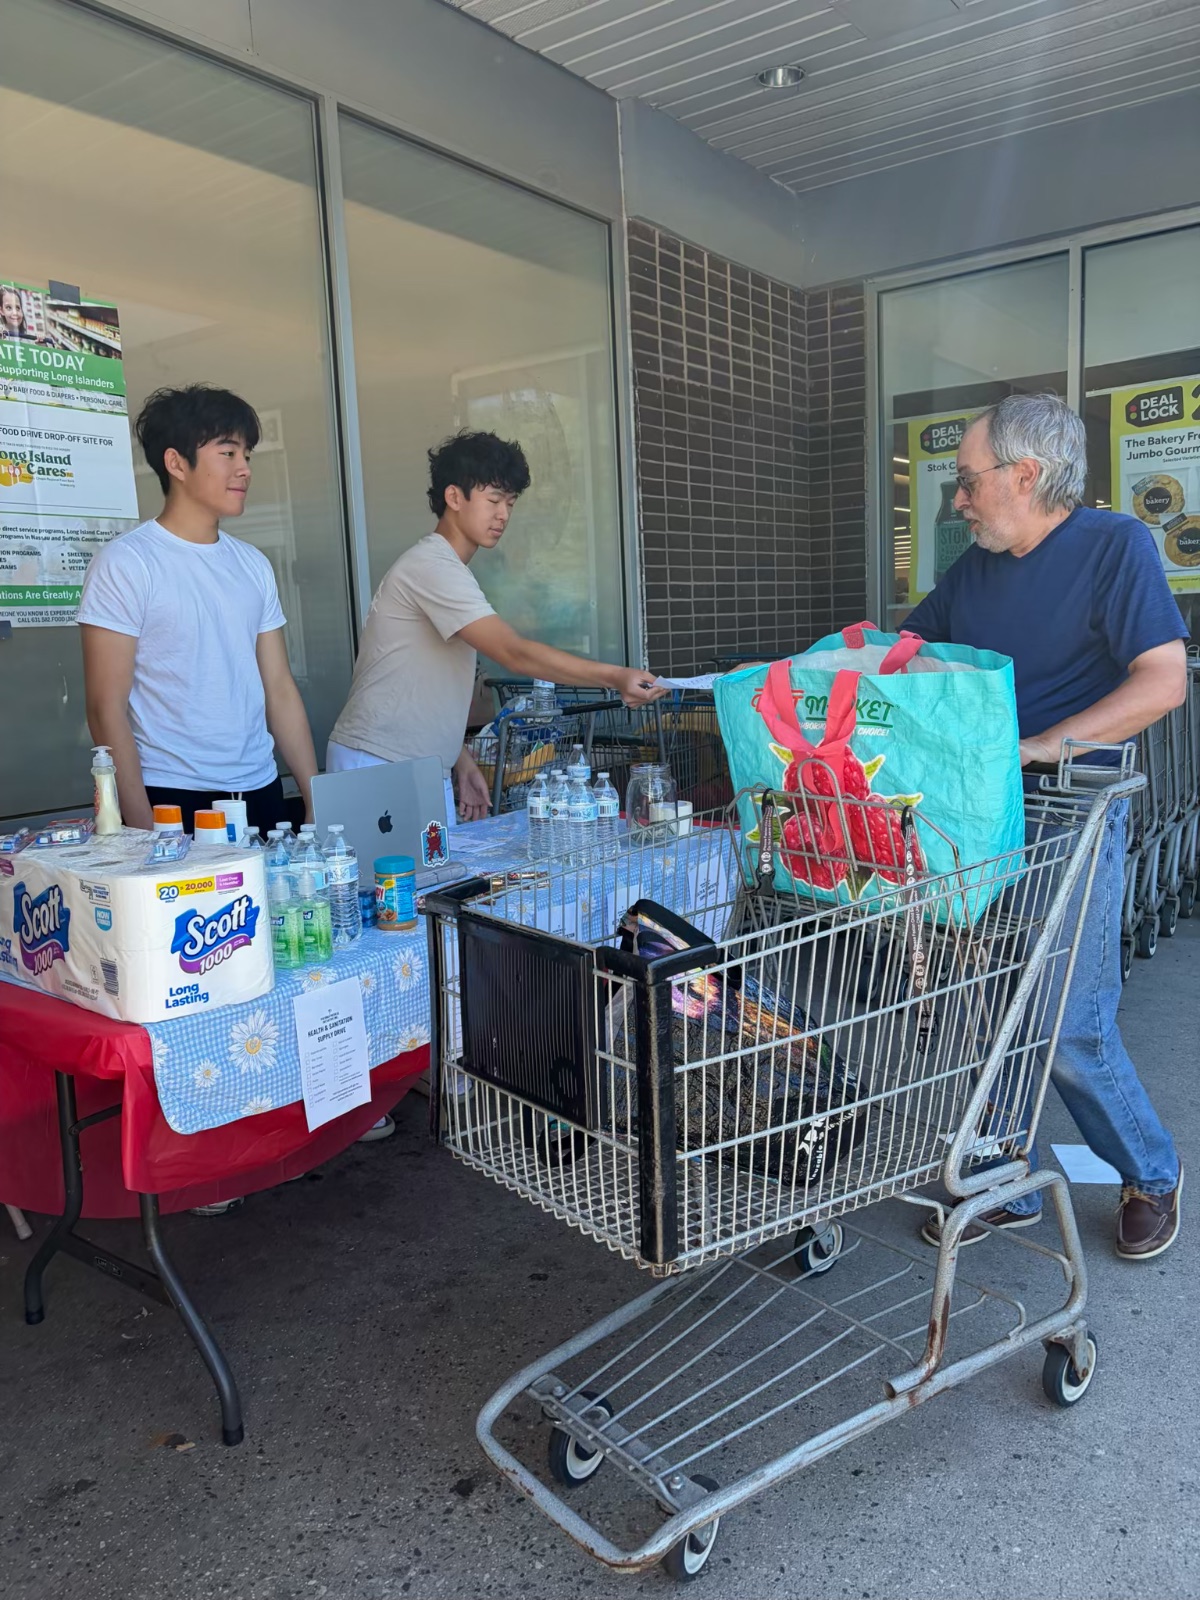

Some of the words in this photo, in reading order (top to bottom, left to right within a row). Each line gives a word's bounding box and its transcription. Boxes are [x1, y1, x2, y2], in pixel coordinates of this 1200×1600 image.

[29, 348, 85, 372] TODAY
[0, 364, 50, 380] Supporting
[51, 371, 74, 384] Long
[75, 375, 115, 389] Islanders
[52, 392, 75, 400] DIAPERS
[80, 396, 108, 405] PERSONAL
[1140, 393, 1178, 410] DEAL
[1140, 404, 1179, 421] LOCK
[21, 429, 43, 439] DRIVE
[44, 432, 81, 443] DROP-OFF
[82, 436, 98, 445] SITE
[99, 438, 113, 447] FOR
[931, 425, 963, 438] DEAL
[932, 434, 963, 449] LOCK
[1125, 439, 1146, 449] The
[1147, 435, 1185, 446] Bakery
[28, 450, 71, 466] Island
[1126, 449, 1163, 461] Jumbo
[26, 462, 67, 478] Cares
[927, 463, 947, 472] Stok
[1145, 496, 1170, 506] bakery
[25, 590, 41, 600] Are
[42, 590, 73, 601] Greatly
[805, 695, 895, 722] MKET
[857, 728, 889, 736] CHOICE!
[159, 886, 179, 900] 20
[21, 886, 61, 945] Scott
[183, 895, 250, 956] Scott
[33, 946, 53, 976] 1000
[199, 943, 233, 975] 1000
[169, 983, 199, 998] Long
[165, 991, 209, 1009] Lasting
[307, 1026, 325, 1037] HEALTH
[329, 1015, 353, 1030] SANITATION
[317, 1031, 334, 1043] SUPPLY
[334, 1026, 346, 1037] DRIVE
